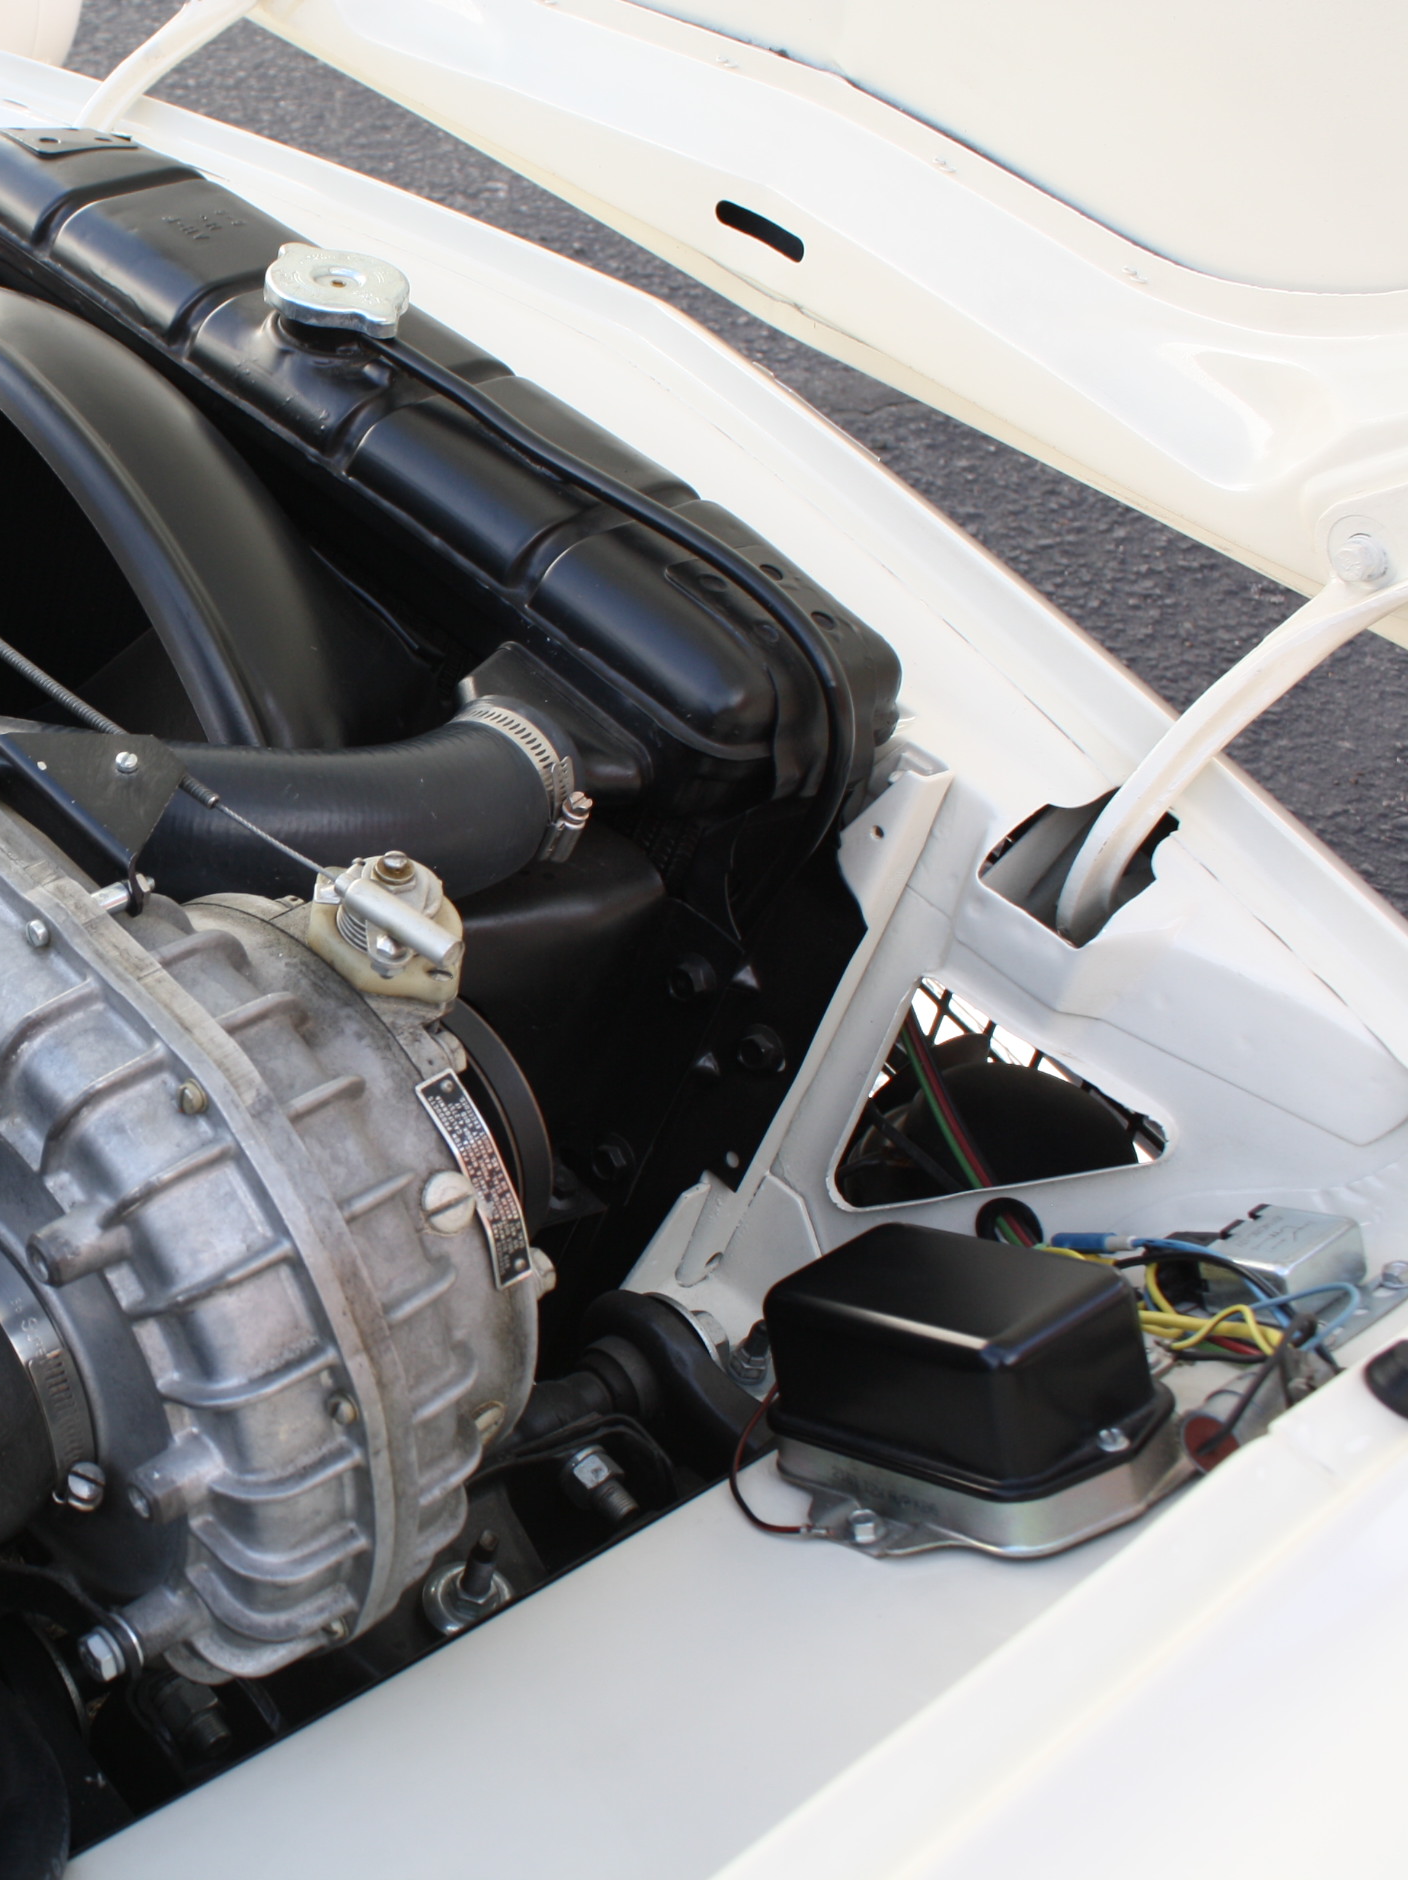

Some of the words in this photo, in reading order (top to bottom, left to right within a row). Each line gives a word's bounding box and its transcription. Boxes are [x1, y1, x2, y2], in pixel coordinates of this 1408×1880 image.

[427, 1095, 454, 1132] PRODUCTS
[434, 1095, 463, 1135] CALIFORNIA
[449, 1132, 471, 1162] PAXTON
